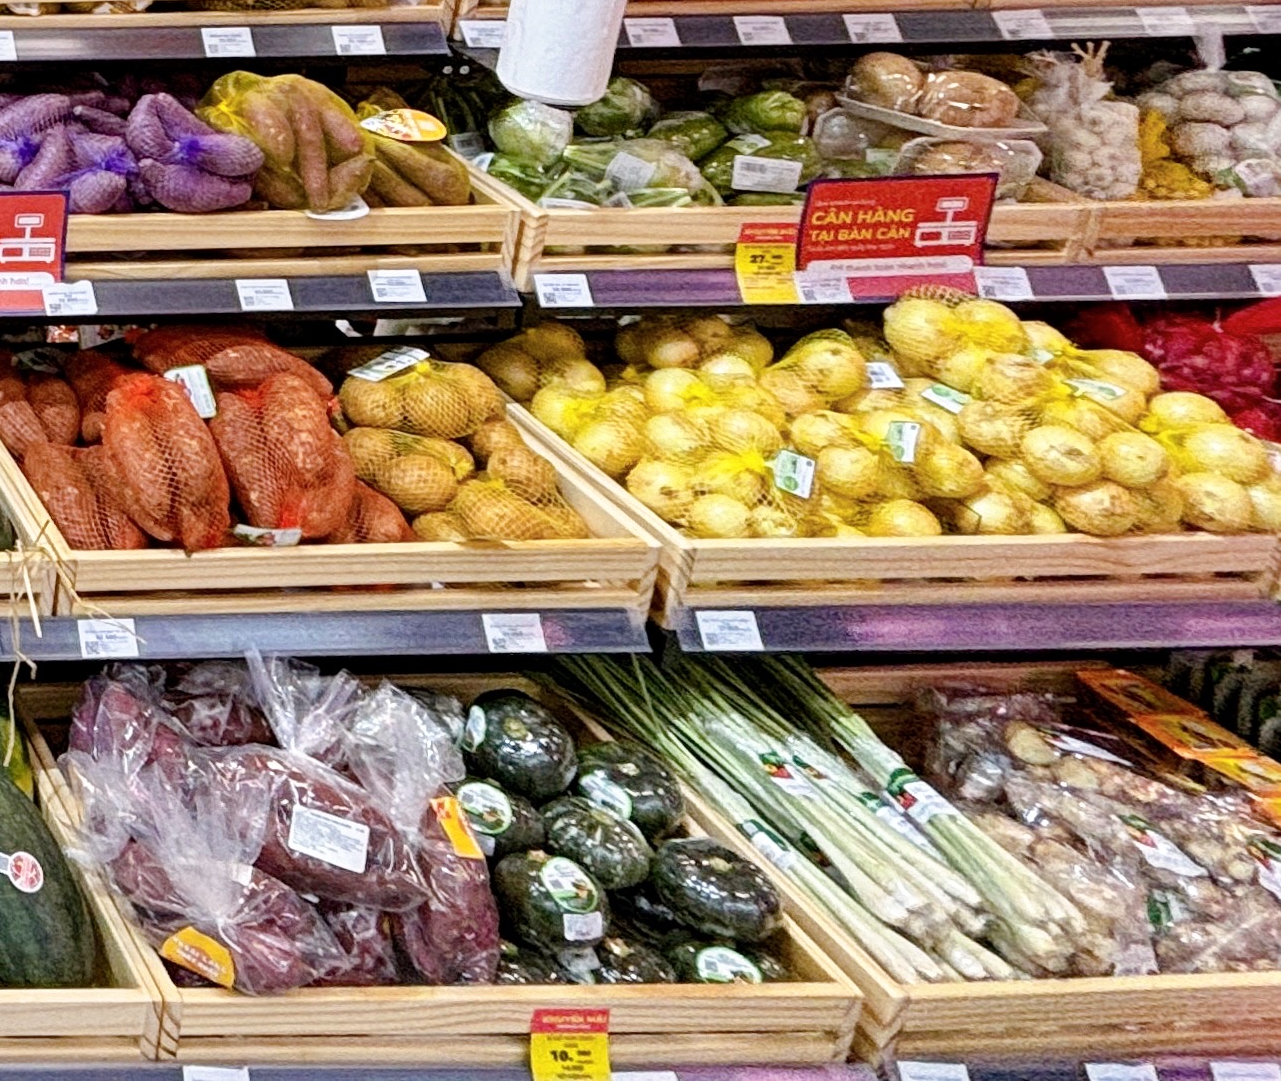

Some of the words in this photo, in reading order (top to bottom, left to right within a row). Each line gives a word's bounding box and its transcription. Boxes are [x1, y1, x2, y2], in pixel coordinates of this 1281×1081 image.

[812, 207, 852, 225] CÂN
[857, 206, 916, 224] HÀNG
[811, 229, 835, 243] TẠI
[838, 226, 872, 241] BÀN
[876, 226, 912, 240] CÂN
